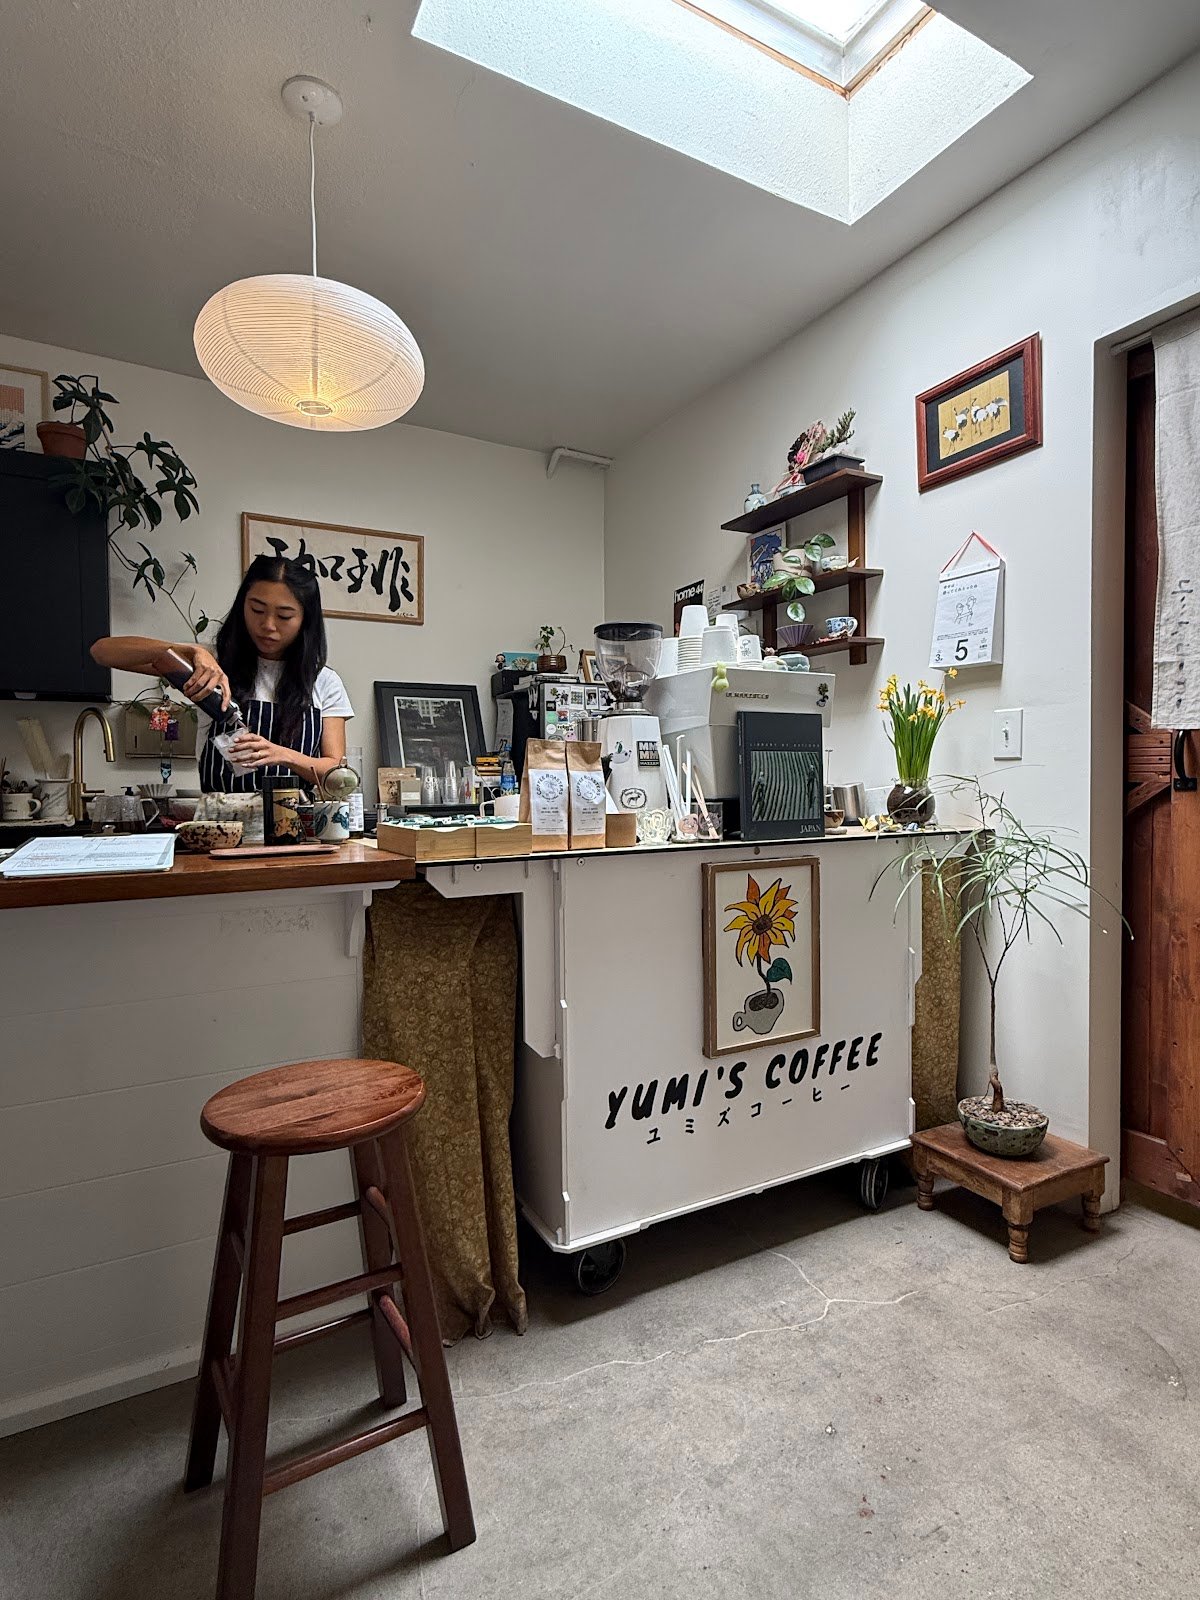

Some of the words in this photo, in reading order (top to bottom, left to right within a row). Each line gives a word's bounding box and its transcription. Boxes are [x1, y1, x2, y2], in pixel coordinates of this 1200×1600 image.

[954, 638, 969, 661] 5
[800, 824, 821, 833] JAPAN
[603, 1062, 748, 1130] YUMI'S
[765, 1032, 883, 1091] COFFEE
[646, 1085, 852, 1145] ユミズコーヒー
